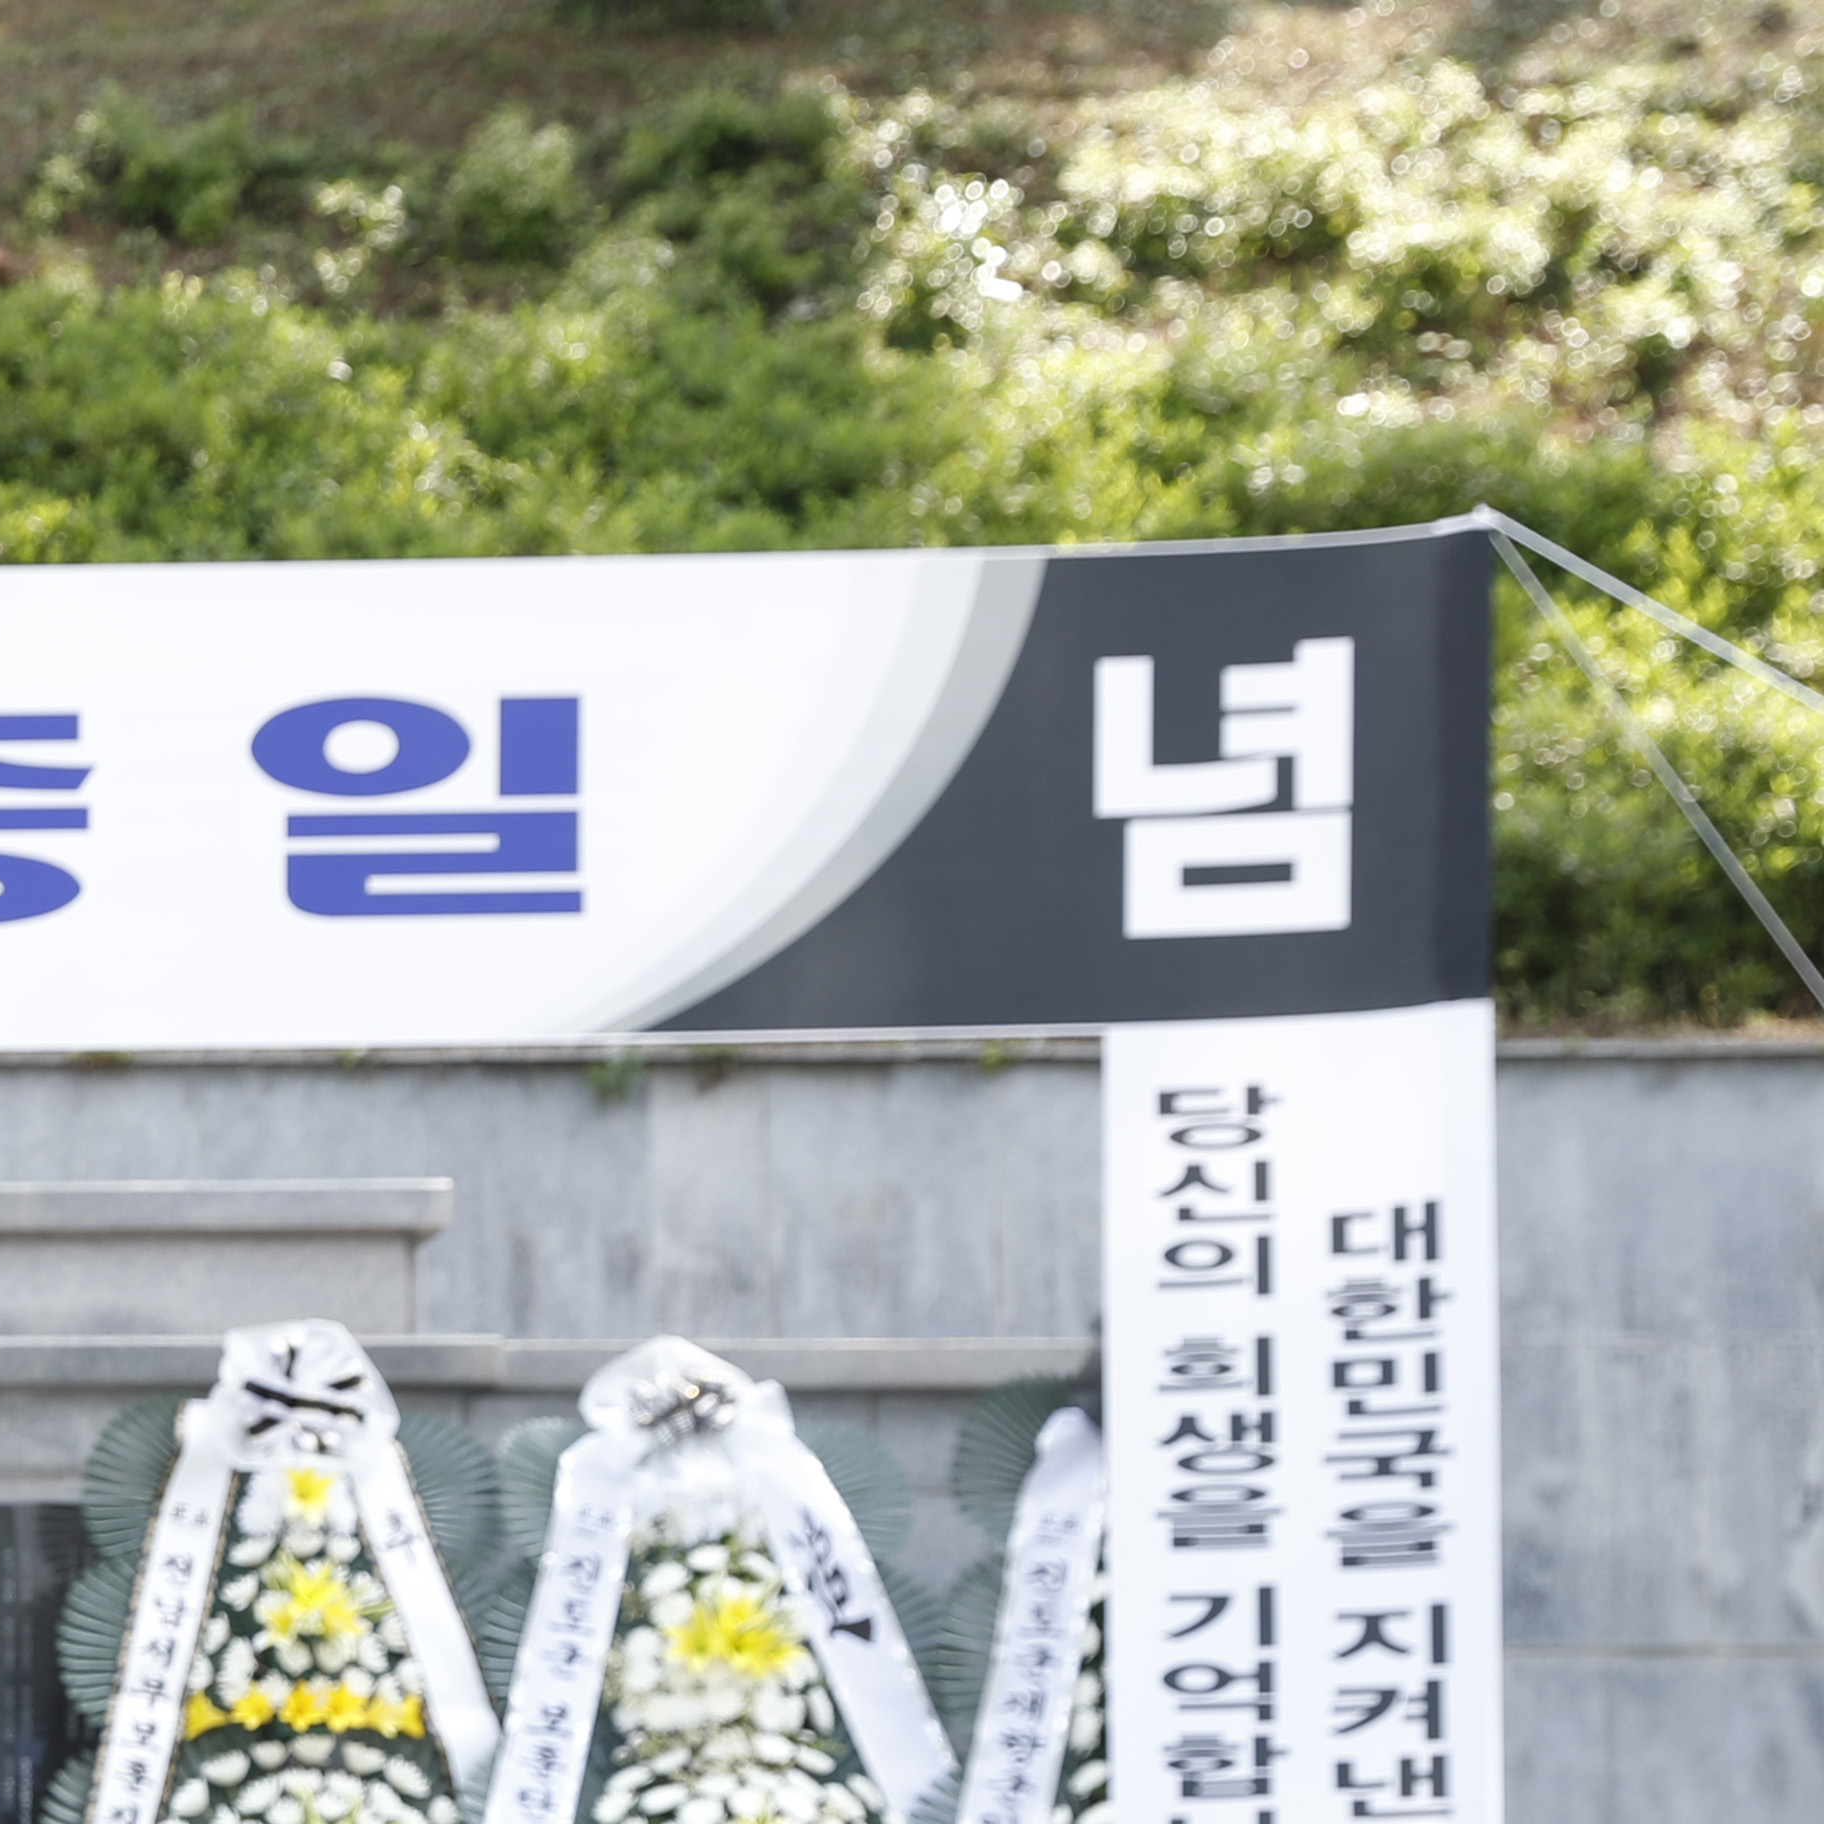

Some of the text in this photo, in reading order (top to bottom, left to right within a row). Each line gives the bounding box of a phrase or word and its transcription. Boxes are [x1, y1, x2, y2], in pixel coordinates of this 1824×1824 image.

[1092, 636, 1356, 940] 념
[1156, 1084, 1280, 1297] 당신의
[1155, 1334, 1283, 1551] 희생을
[1324, 1199, 1454, 1820] 대한민국을 지켜낸
